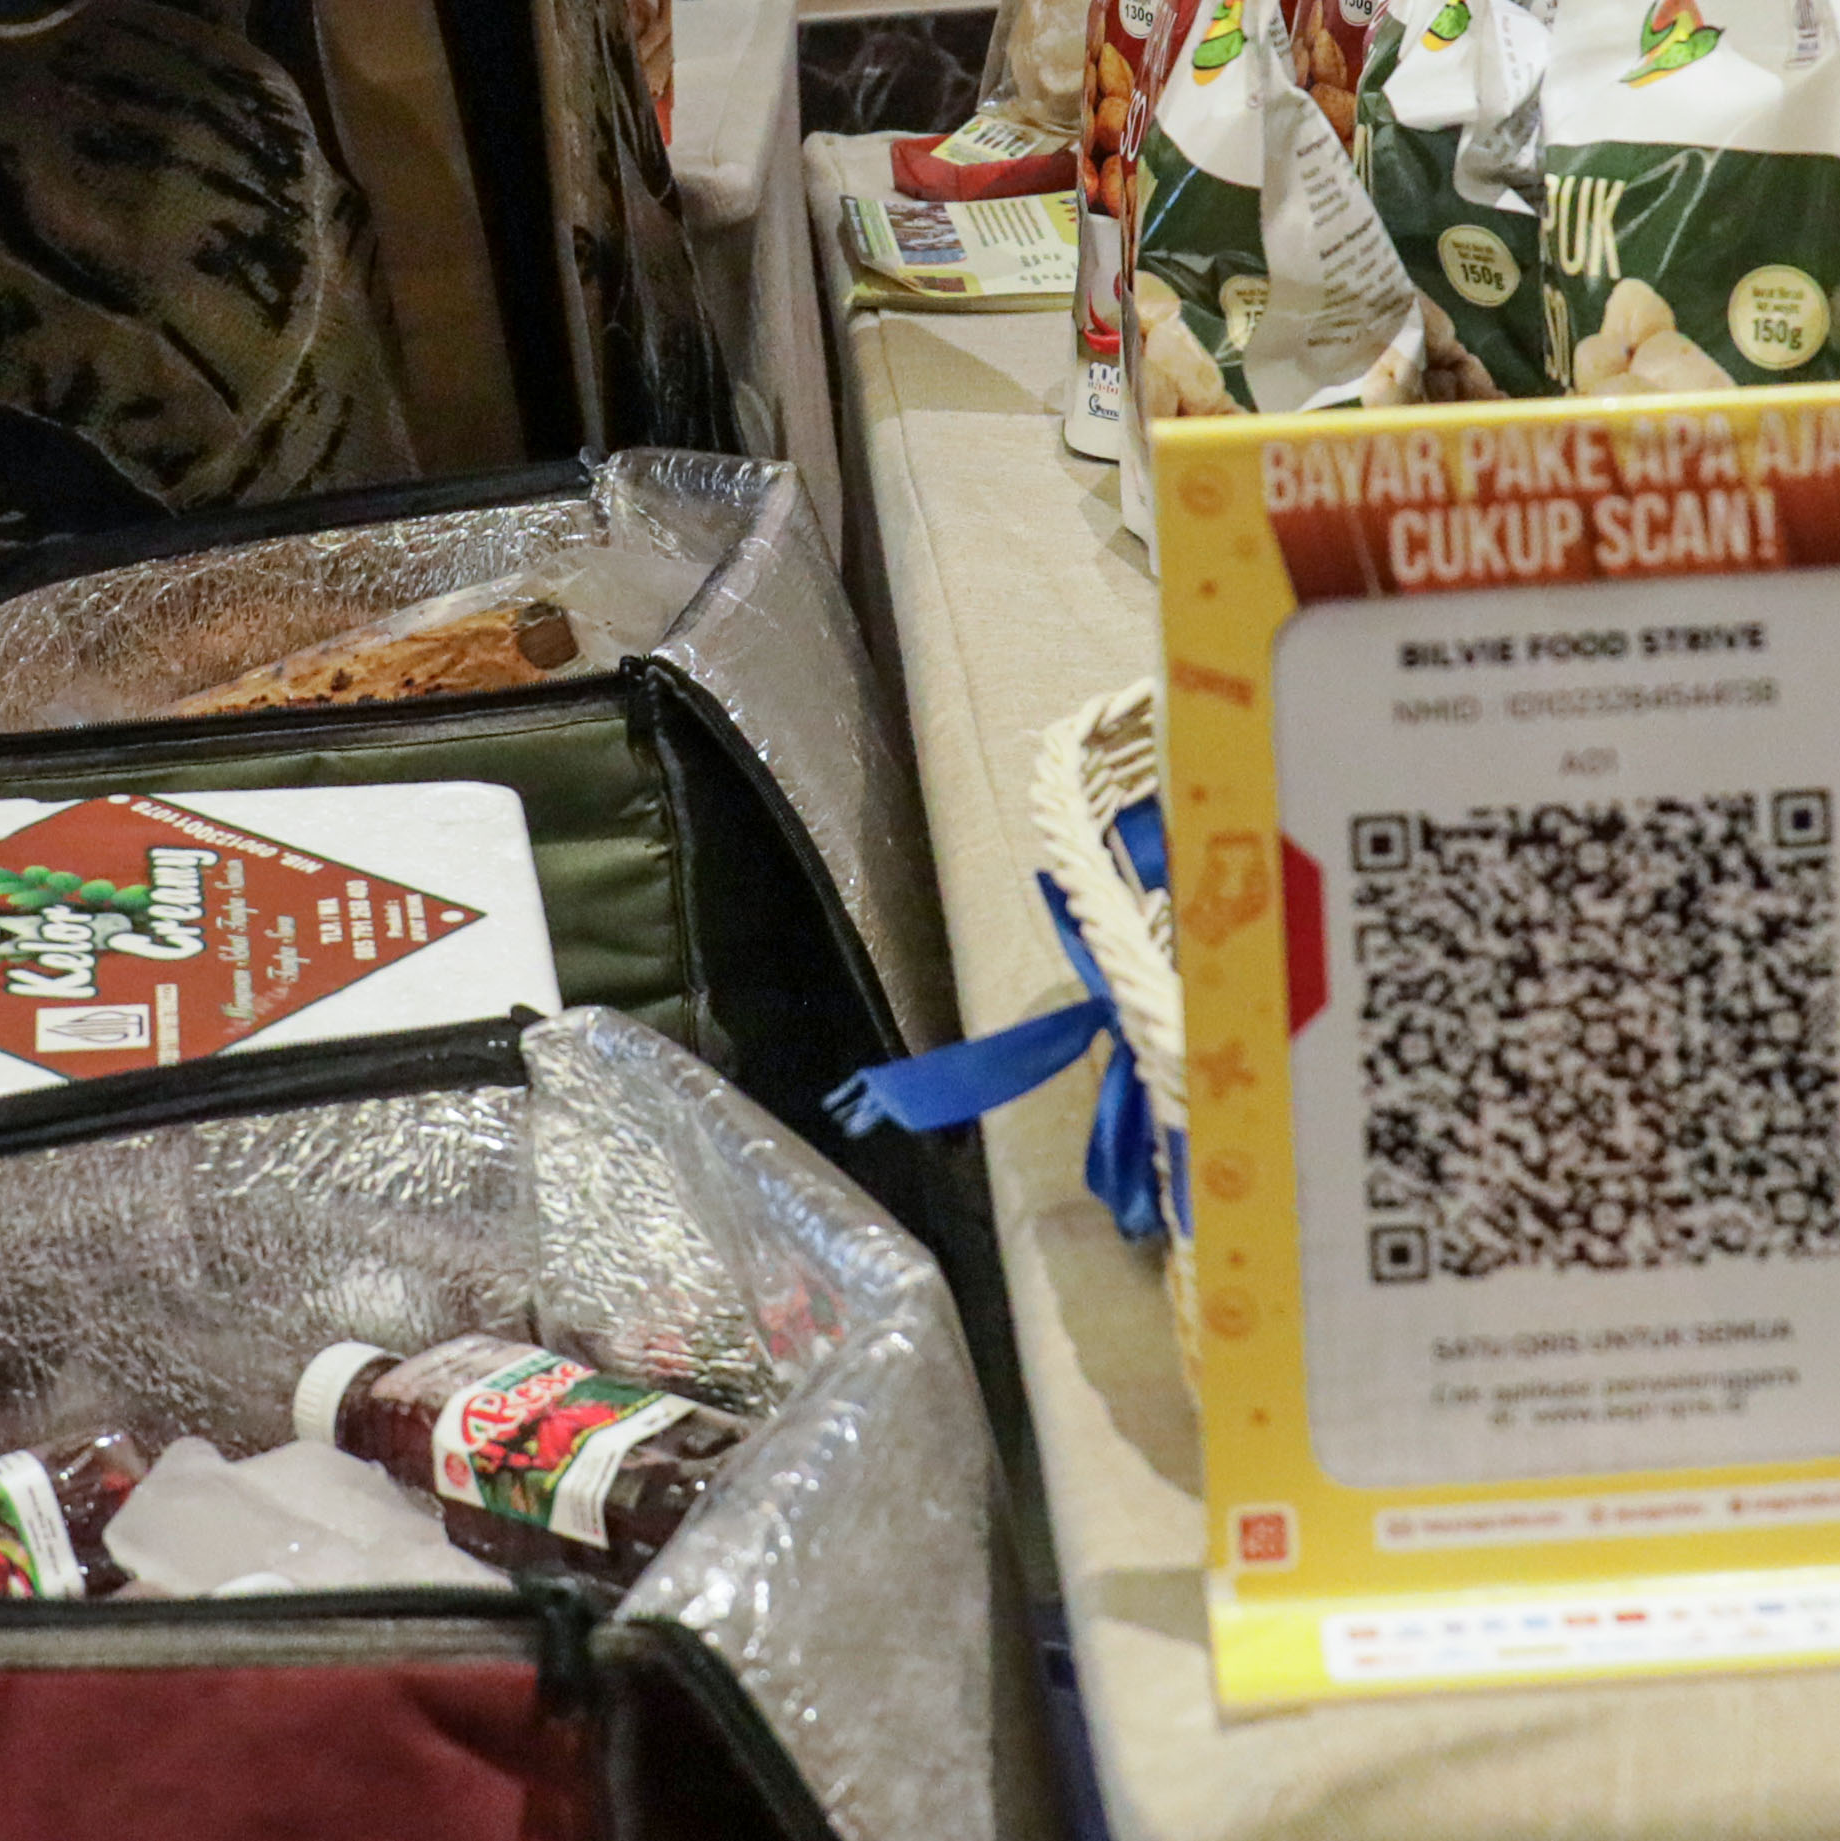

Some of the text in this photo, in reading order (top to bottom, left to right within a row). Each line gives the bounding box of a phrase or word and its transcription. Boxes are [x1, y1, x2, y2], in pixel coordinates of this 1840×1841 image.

[1124, 5, 1154, 28] 130g
[1461, 262, 1506, 292] 150g
[1751, 318, 1804, 351] 150g
[1261, 426, 1447, 514] BAYAR
[1460, 420, 1612, 504] PAKE
[1625, 409, 1741, 488] APA
[1388, 498, 1584, 585] CUKUP
[1399, 621, 1765, 669] BILVIE FOOD STRIVE
[105, 845, 221, 961] Creamy
[6, 903, 99, 999] Kelor
